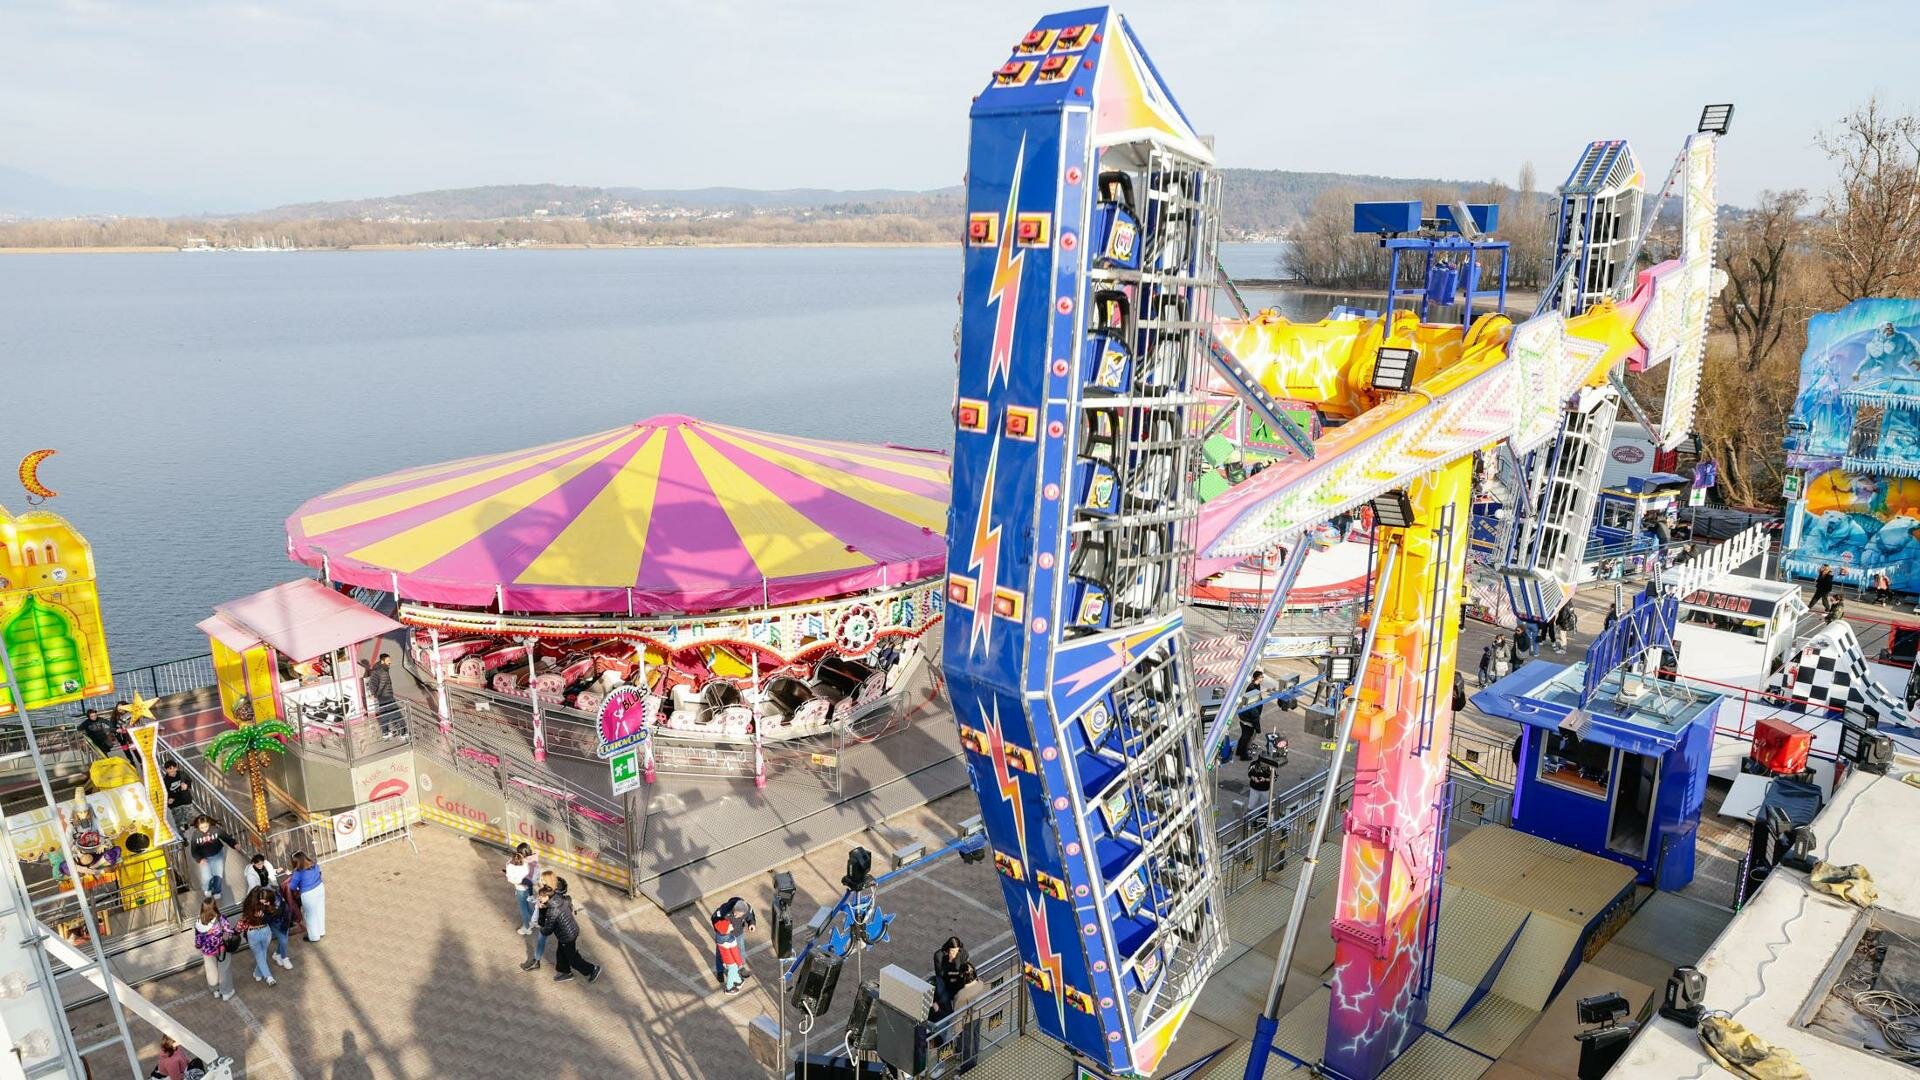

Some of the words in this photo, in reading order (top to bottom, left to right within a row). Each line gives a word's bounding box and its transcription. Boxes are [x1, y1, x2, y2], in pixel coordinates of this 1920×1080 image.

[1711, 593, 1752, 613] MAN
[622, 684, 648, 711] BLUES
[435, 795, 488, 823] Cotton
[518, 822, 556, 845] Club
